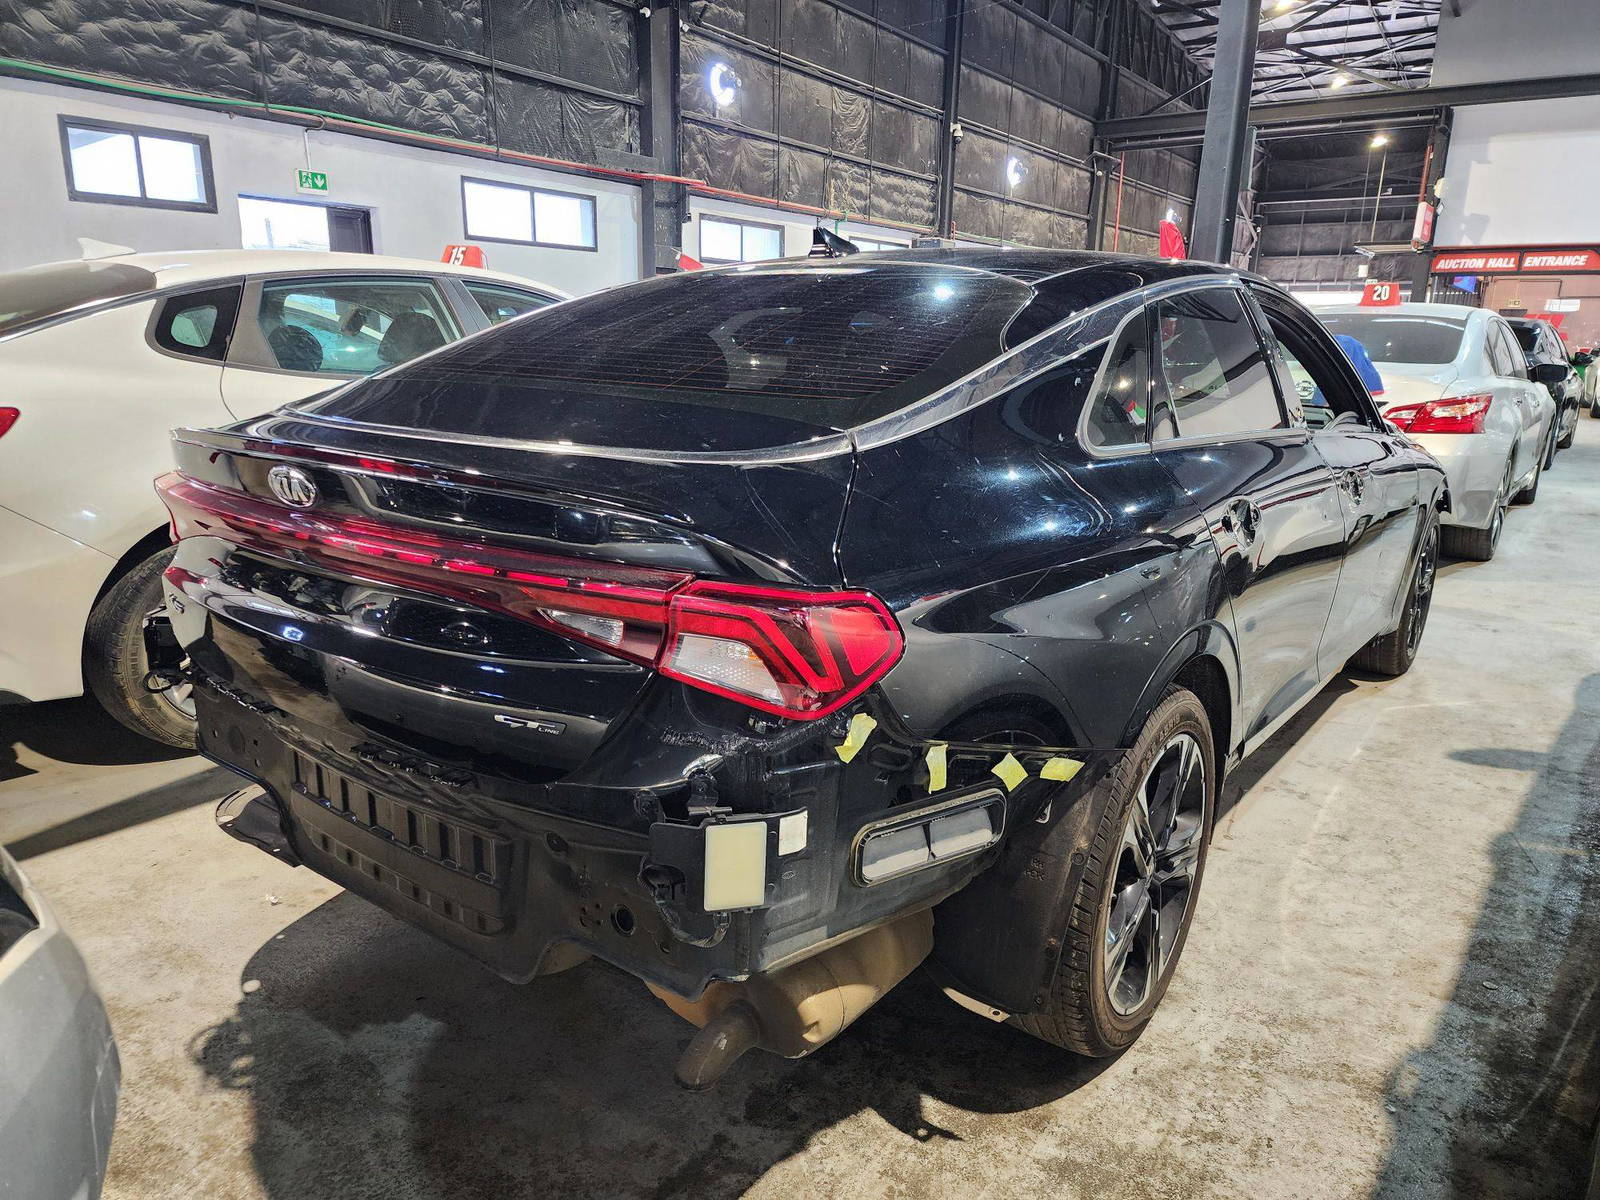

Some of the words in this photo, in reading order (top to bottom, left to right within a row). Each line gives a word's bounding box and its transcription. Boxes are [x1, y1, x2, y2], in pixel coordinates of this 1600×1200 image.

[449, 246, 466, 265] 15
[1436, 258, 1485, 269] AUCTION
[1486, 257, 1515, 268] HALL
[1523, 255, 1589, 267] ENTRANCE
[1372, 285, 1390, 301] 20
